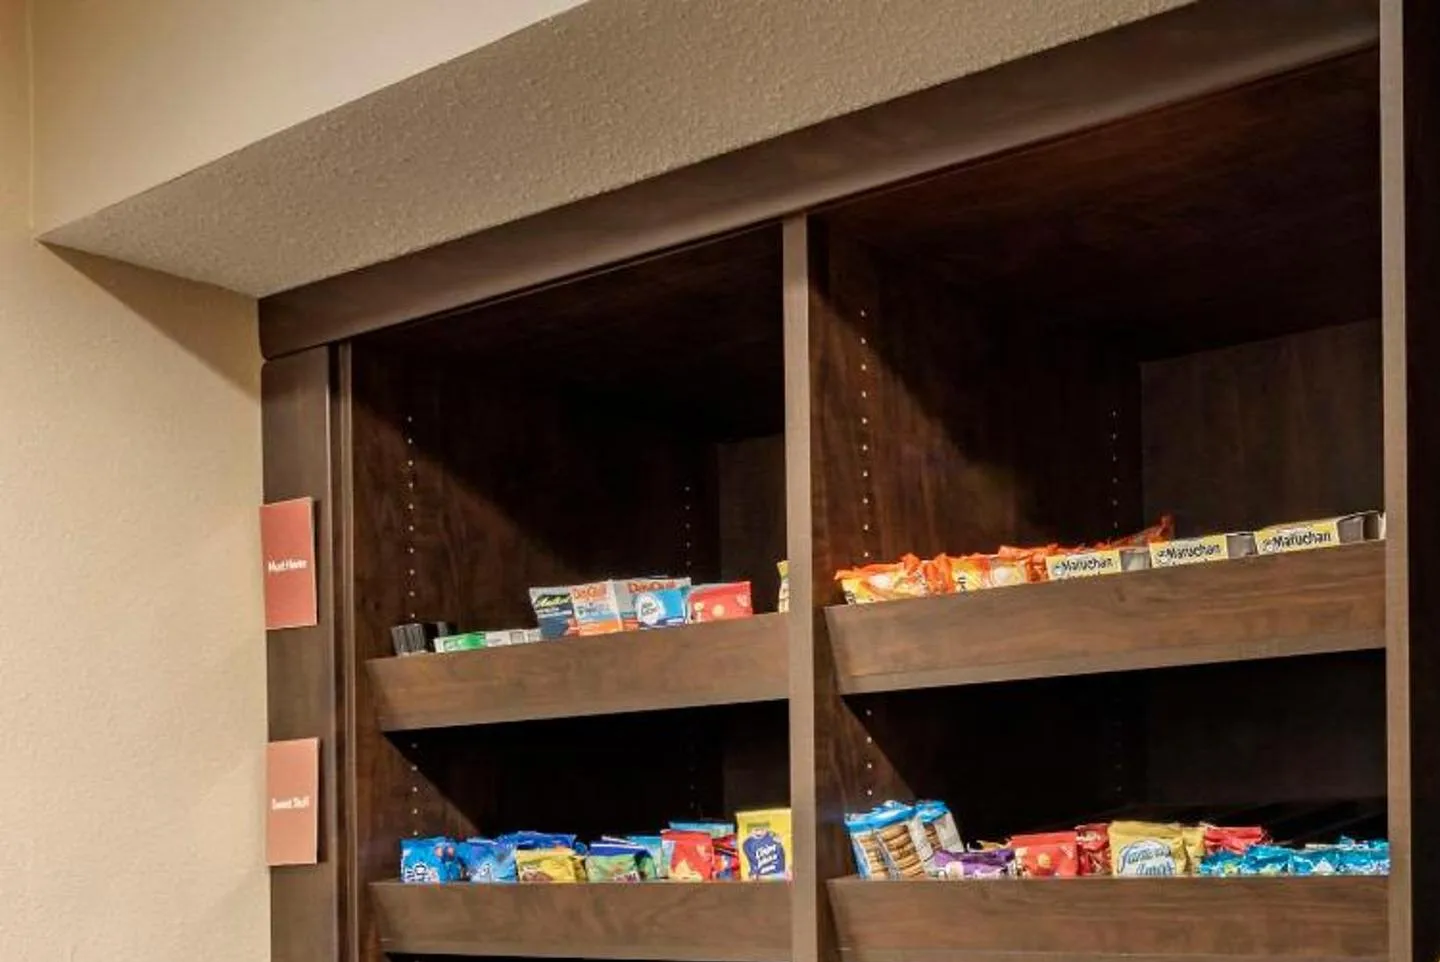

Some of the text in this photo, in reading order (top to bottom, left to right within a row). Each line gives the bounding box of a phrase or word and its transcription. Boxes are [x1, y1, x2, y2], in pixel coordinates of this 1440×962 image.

[1273, 531, 1331, 547] Maruchan
[1163, 543, 1221, 559] Maruchan
[1061, 557, 1113, 571] Maruchan
